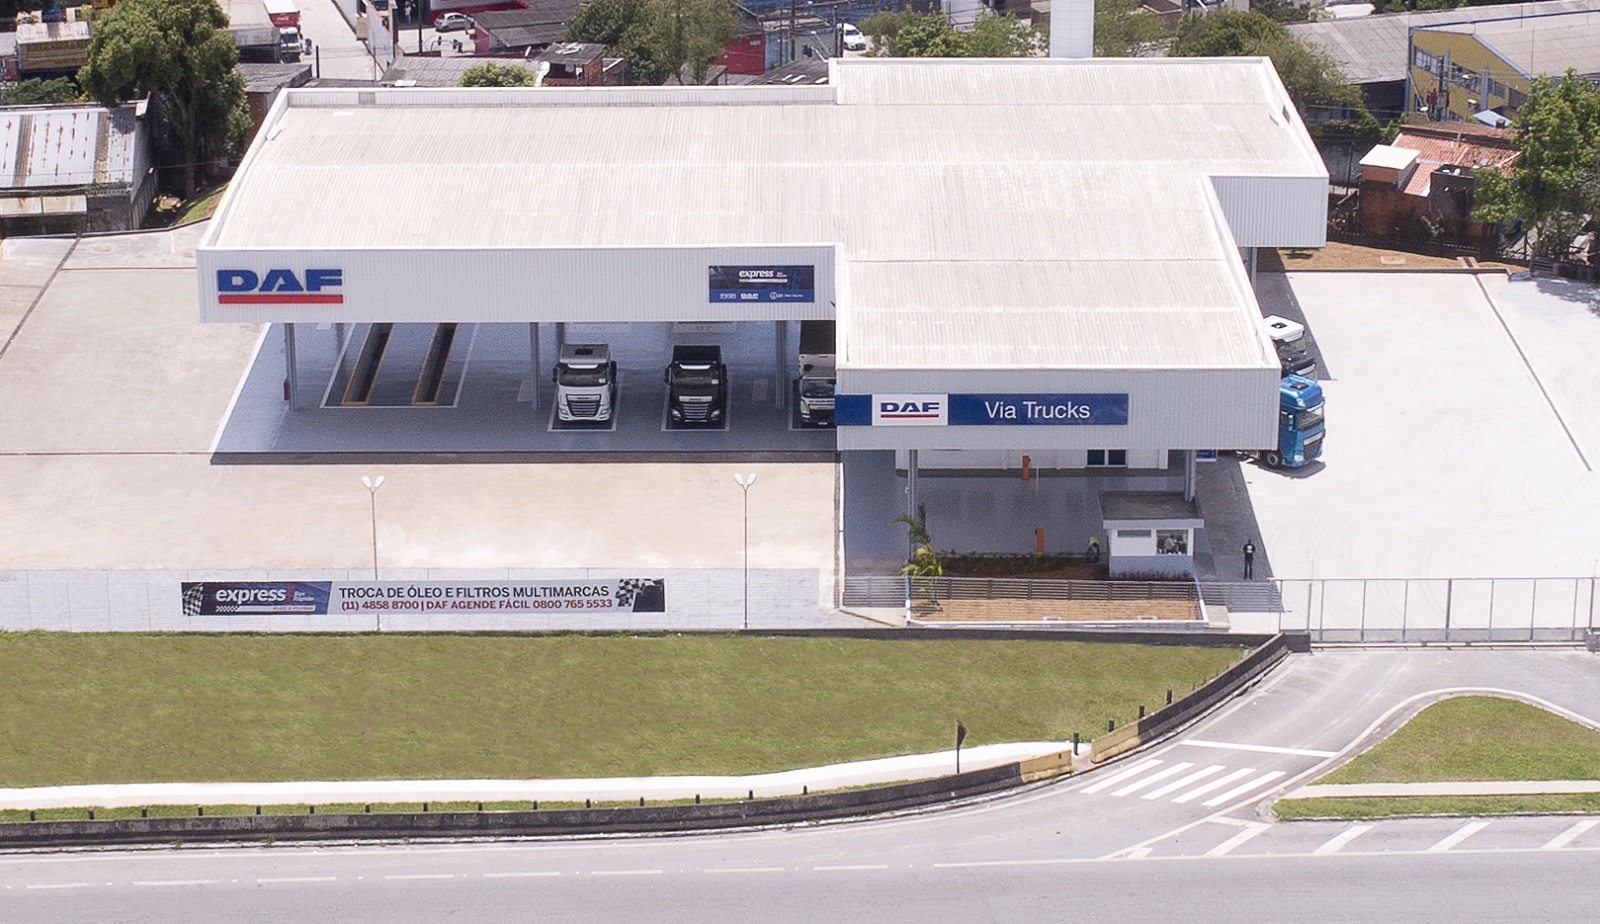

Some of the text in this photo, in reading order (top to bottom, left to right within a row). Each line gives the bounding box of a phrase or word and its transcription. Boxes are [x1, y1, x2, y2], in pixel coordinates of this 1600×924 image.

[217, 269, 342, 292] DAF
[880, 402, 939, 412] DAF
[985, 401, 1090, 419] Via Trucks
[339, 585, 609, 598] TROCA DE ÓLEO E FILTROS MULTIMARCAS
[341, 601, 359, 611] (11)
[362, 601, 389, 610] 4858
[392, 601, 419, 610] 8700
[426, 601, 448, 610] DAF
[451, 600, 496, 610] AGENDE
[499, 598, 530, 609] FÁCIL
[533, 600, 562, 609] 0800
[565, 599, 584, 609] 765
[586, 599, 613, 608] 5533
